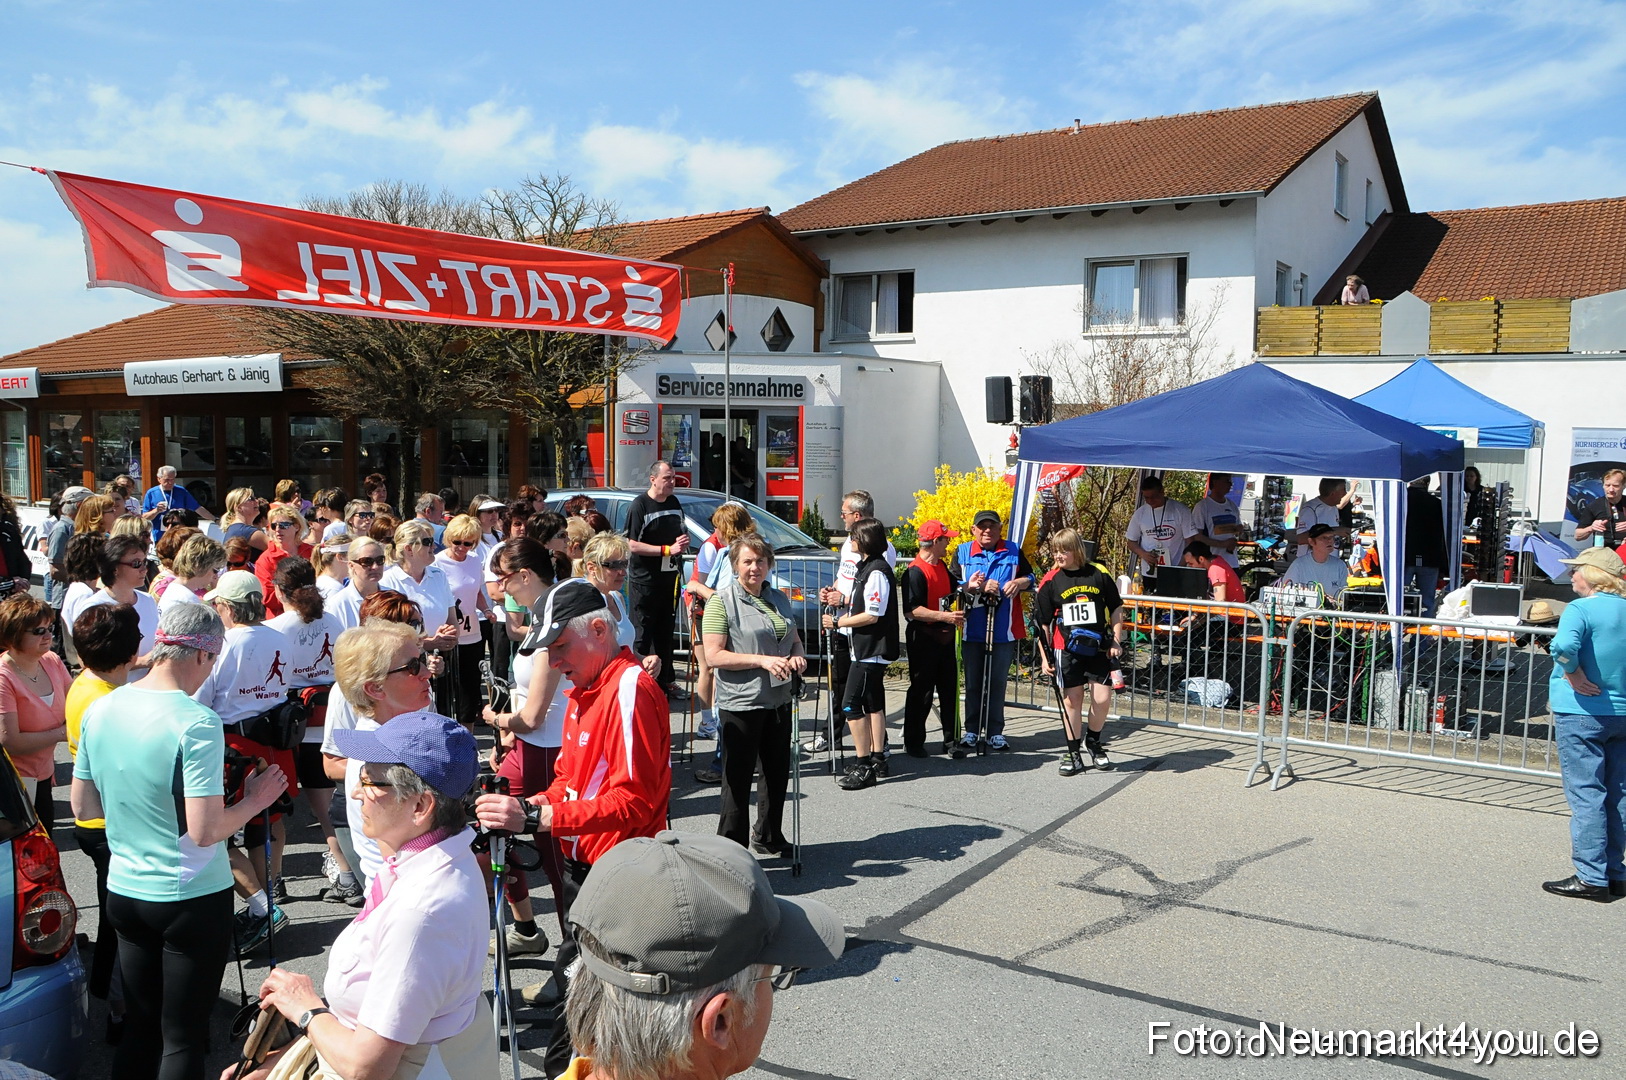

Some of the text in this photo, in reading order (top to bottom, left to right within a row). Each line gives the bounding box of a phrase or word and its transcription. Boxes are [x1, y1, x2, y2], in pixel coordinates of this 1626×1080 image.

[0, 377, 29, 389] EAT
[133, 366, 270, 386] Autohaus Gerhart & Jänig
[658, 374, 804, 398] Serviceannahme
[1574, 441, 1618, 449] NÜRNBERGER
[1068, 603, 1090, 622] 115
[239, 685, 266, 695] Nordic
